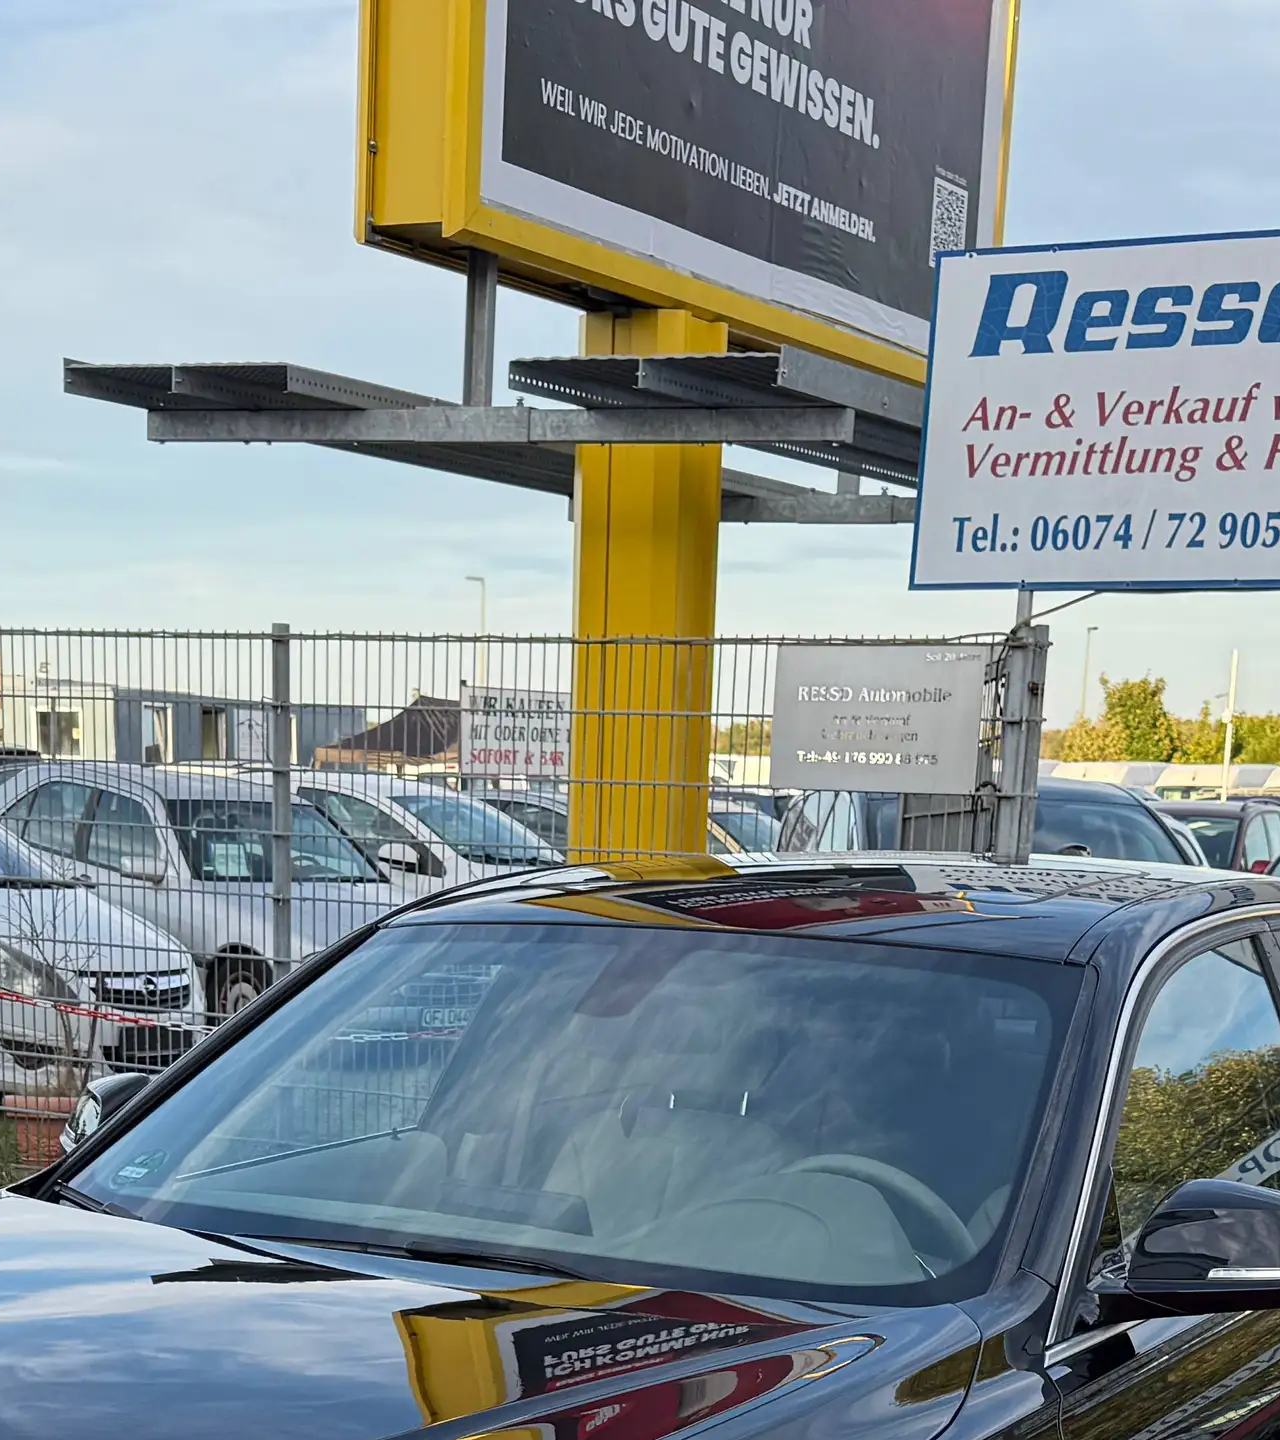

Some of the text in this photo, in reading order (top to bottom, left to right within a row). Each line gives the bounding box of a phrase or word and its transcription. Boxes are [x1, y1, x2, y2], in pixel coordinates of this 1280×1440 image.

[642, 0, 880, 150] GUTE GEWISSEN.
[541, 78, 877, 243] WEIL WIR JEDE MOTIVATION LIEBEN. JETZT ANMELDEN.
[961, 396, 1032, 432] An-
[1044, 393, 1075, 429] &
[1095, 382, 1262, 427] Verkauf
[965, 435, 1204, 483] Vermittlung
[1214, 434, 1249, 472] &
[952, 513, 1020, 553] Tel.:
[1030, 513, 1134, 551] 06074
[1165, 511, 1207, 549] 72
[797, 686, 952, 703] RESSO Automobile
[470, 748, 519, 765] SOFORT
